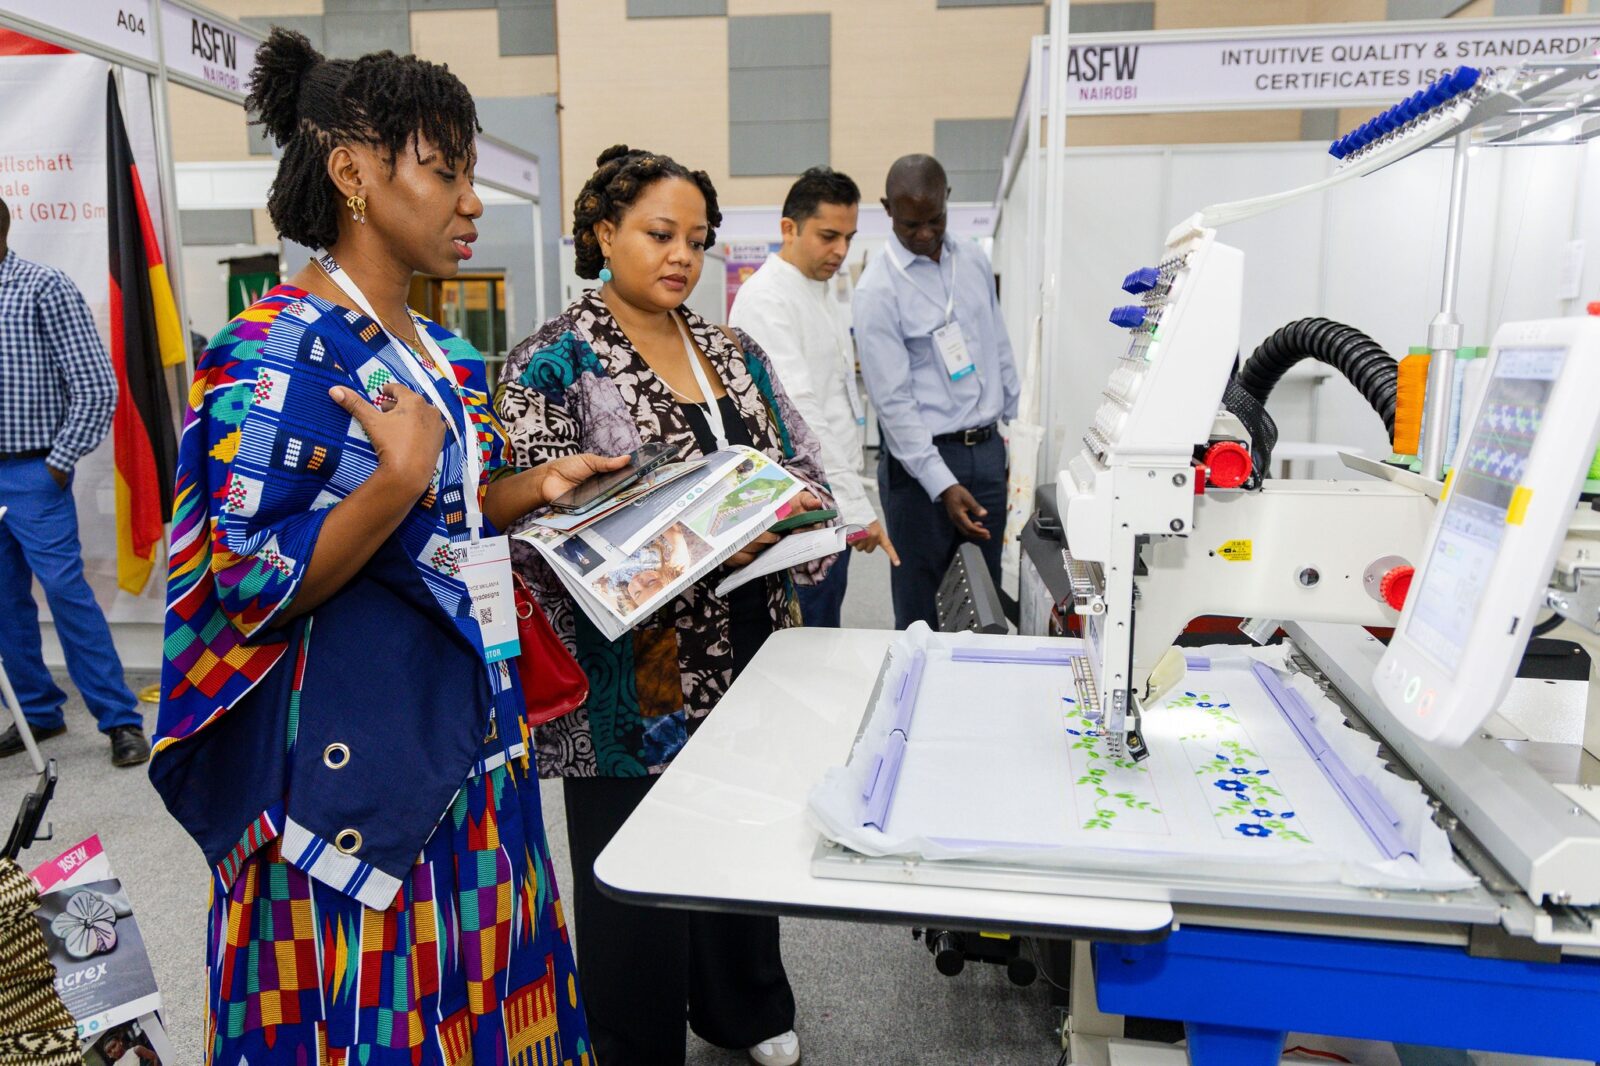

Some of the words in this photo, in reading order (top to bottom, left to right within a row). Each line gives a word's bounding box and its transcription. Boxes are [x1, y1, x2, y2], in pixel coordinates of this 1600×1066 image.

[117, 10, 145, 36] A04
[191, 18, 236, 70] ASFW
[1221, 46, 1324, 66] INTUITIVE
[1331, 42, 1428, 62] QUALITY
[1434, 42, 1448, 58] &
[1067, 45, 1139, 82] ASFW
[203, 65, 240, 90] NAIROBI
[1255, 69, 1410, 90] CERTIFICATES
[1079, 86, 1138, 100] NAIROBI
[30, 202, 76, 222] (GIZ)
[57, 845, 88, 873] ASFW
[54, 962, 107, 990] acrex
